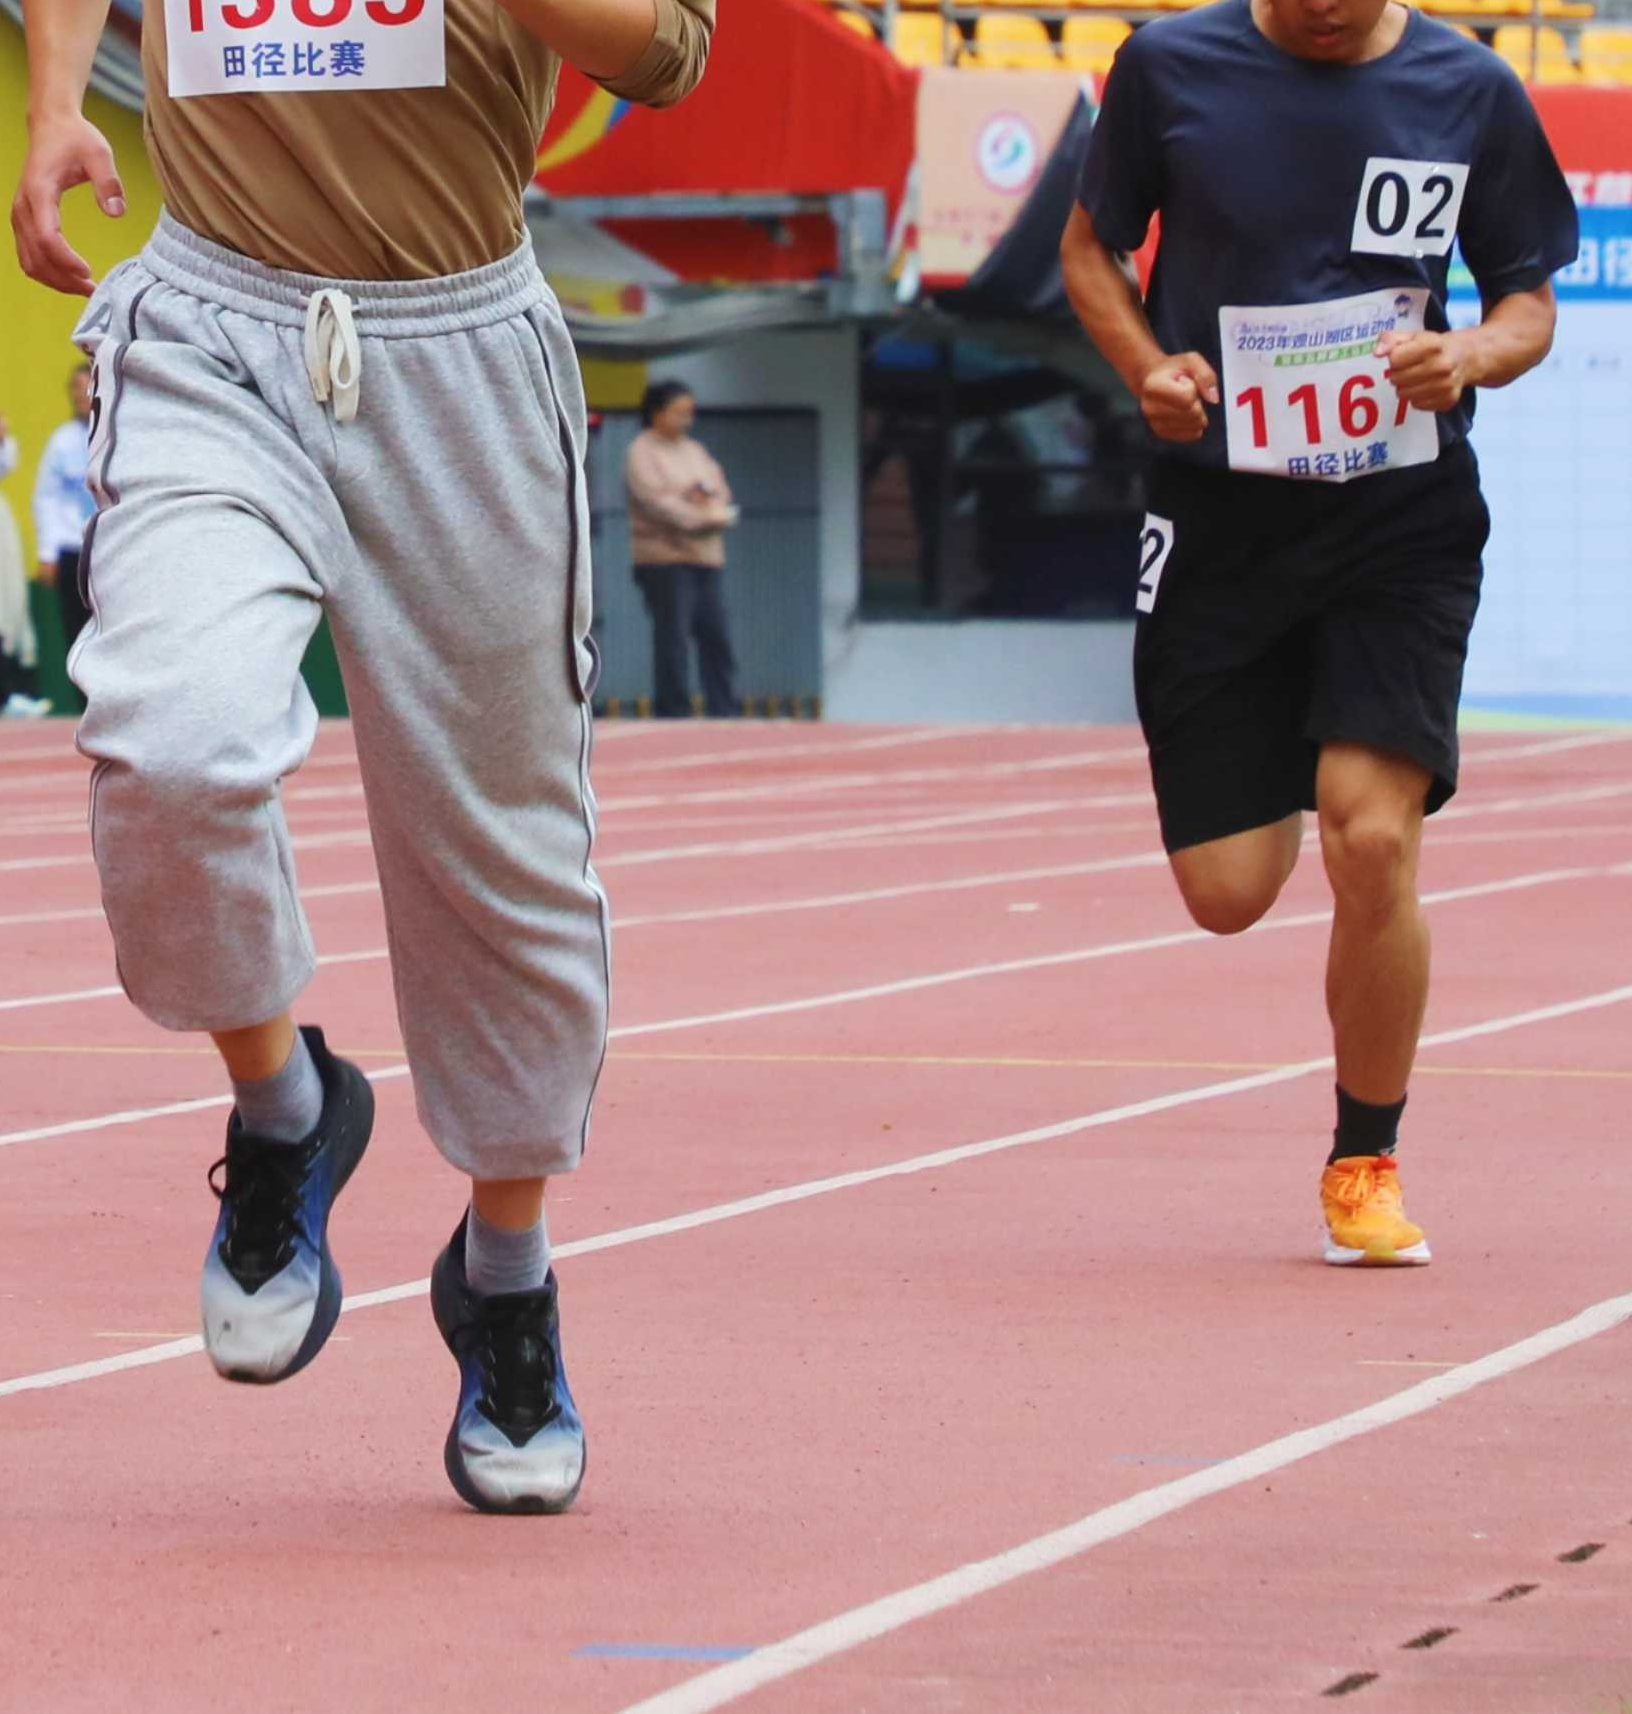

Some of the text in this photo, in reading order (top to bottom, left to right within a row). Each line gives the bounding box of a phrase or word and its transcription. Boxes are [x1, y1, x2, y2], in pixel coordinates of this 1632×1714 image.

[223, 40, 365, 78] 田径比赛
[1366, 171, 1454, 238] 02
[1287, 441, 1388, 476] 田径比赛
